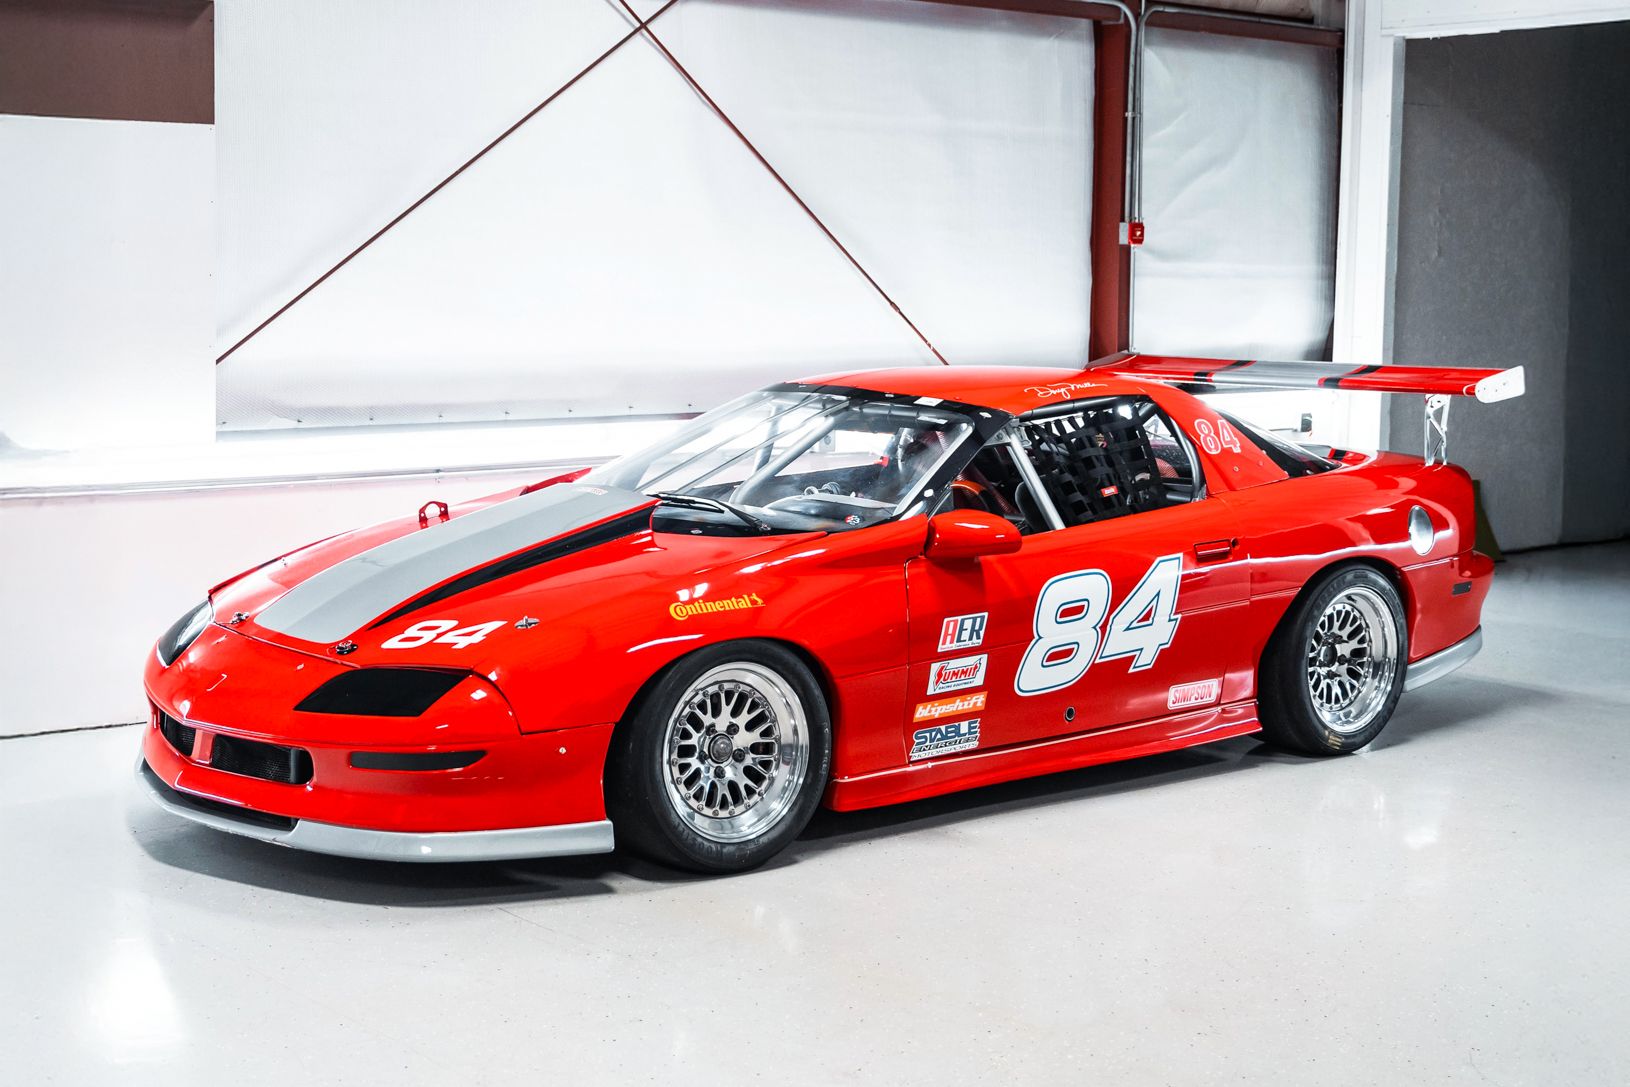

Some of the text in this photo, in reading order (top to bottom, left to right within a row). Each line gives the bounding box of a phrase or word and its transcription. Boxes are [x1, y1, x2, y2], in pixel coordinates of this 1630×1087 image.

[1194, 419, 1241, 454] 84
[669, 595, 752, 620] Continental
[380, 620, 508, 649] 84
[941, 615, 985, 646] AER
[1014, 553, 1183, 696] 84
[915, 694, 985, 718] blipshift
[1172, 683, 1214, 704] SIMPSON
[912, 736, 977, 753] ENERGIES
[914, 720, 979, 746] STABLE
